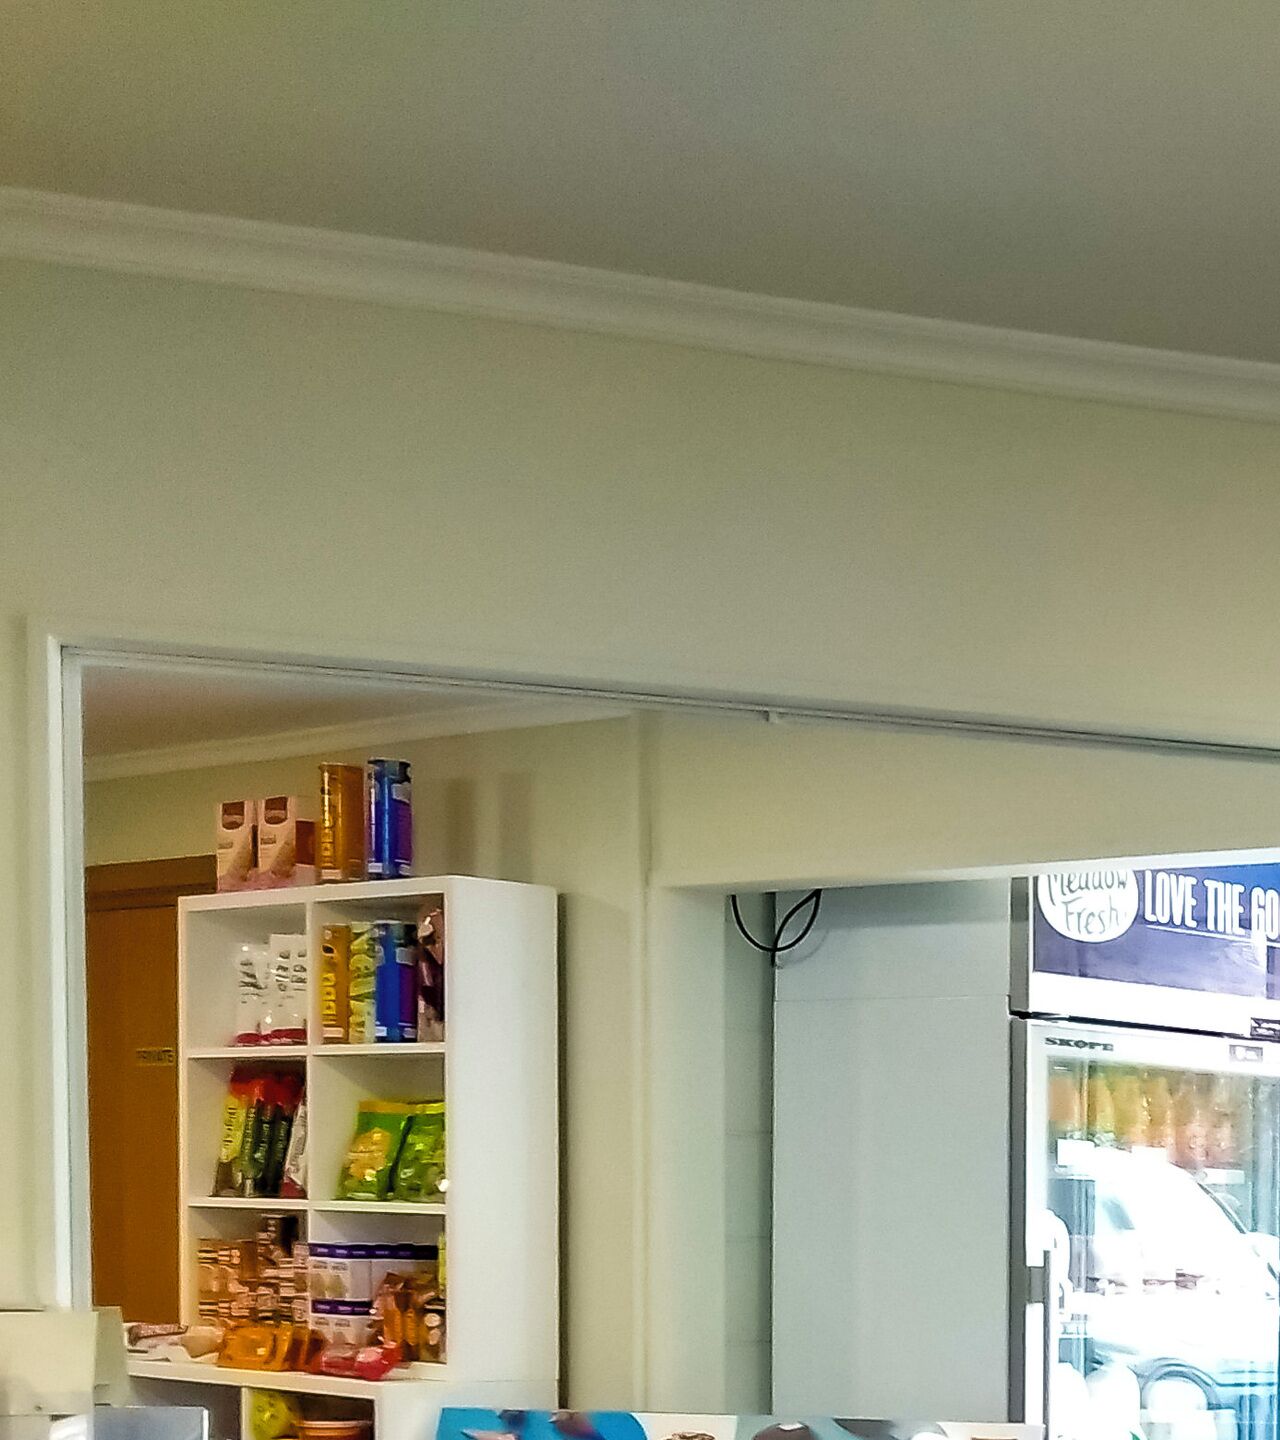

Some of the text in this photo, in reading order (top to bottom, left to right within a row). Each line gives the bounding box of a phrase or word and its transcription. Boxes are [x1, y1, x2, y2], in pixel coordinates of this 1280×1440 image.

[1049, 870, 1127, 905] Meadow
[1144, 870, 1198, 928] LOVE
[1203, 879, 1247, 935] THE
[1062, 896, 1119, 935] Fresh
[1045, 1037, 1114, 1051] SKOPE
